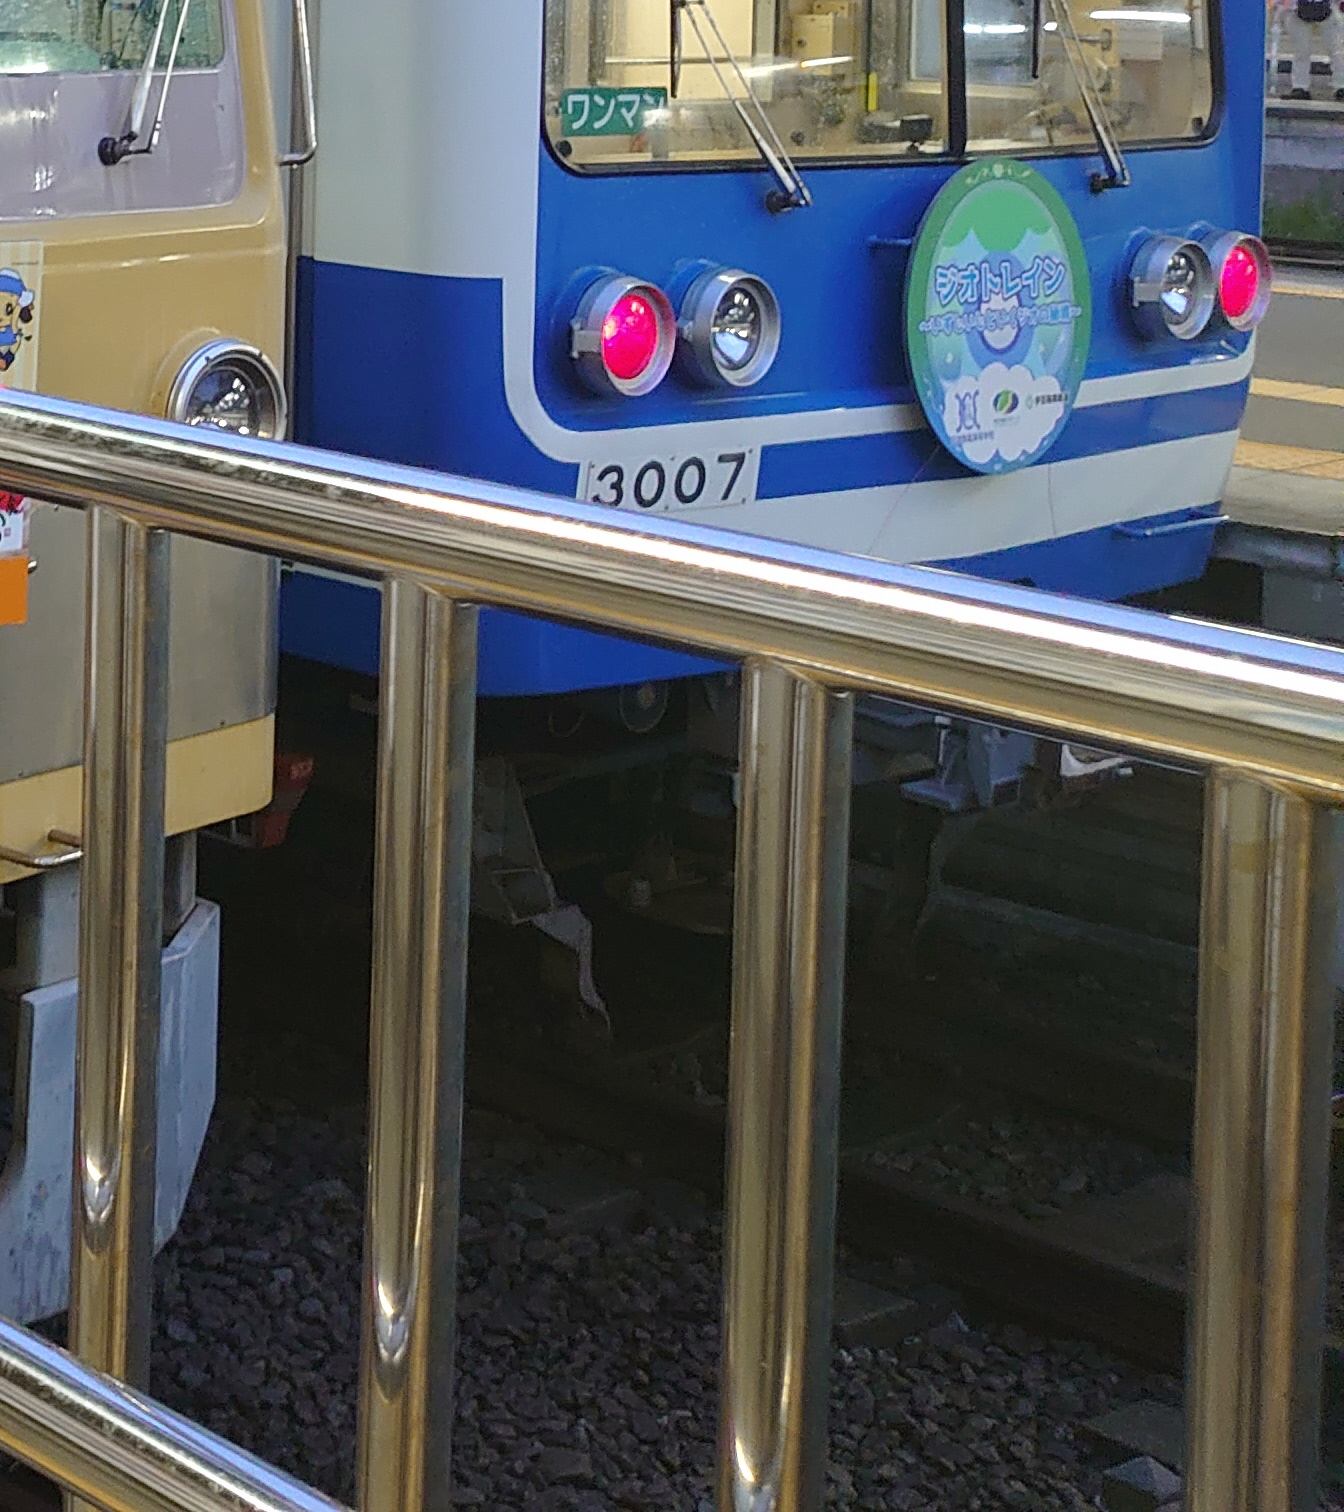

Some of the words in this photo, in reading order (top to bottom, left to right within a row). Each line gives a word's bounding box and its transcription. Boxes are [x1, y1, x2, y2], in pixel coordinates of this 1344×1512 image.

[567, 93, 665, 130] ワンマン
[935, 255, 1067, 307] ジオトレイン
[592, 451, 746, 508] 3007
